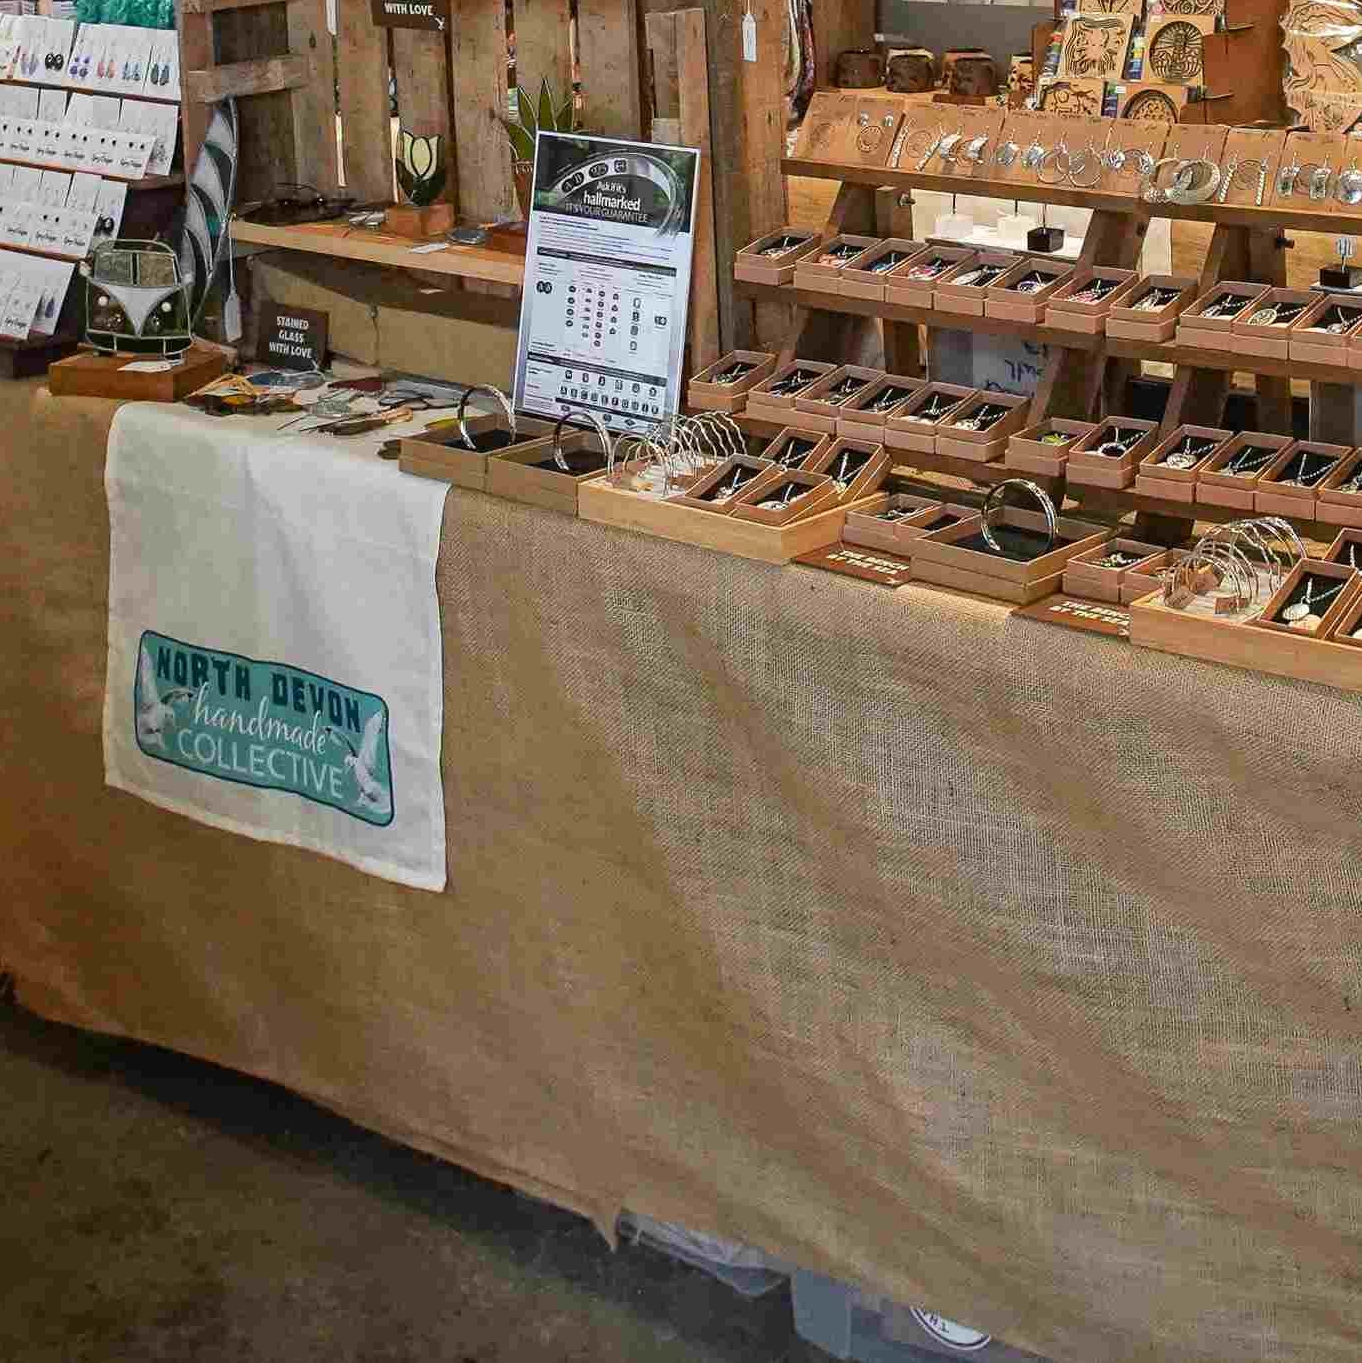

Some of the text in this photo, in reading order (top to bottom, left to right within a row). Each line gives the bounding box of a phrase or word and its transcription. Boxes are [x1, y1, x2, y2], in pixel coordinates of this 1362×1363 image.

[384, 3, 434, 16] WITH LOVE
[583, 190, 641, 211] hallmarked
[276, 316, 309, 330] STAINED
[279, 330, 304, 343] GLASS
[269, 342, 313, 359] WITH LOVE
[156, 645, 361, 733] NORTH DEVON
[192, 680, 326, 754] handmade
[178, 727, 344, 799] COLLECTIVE
